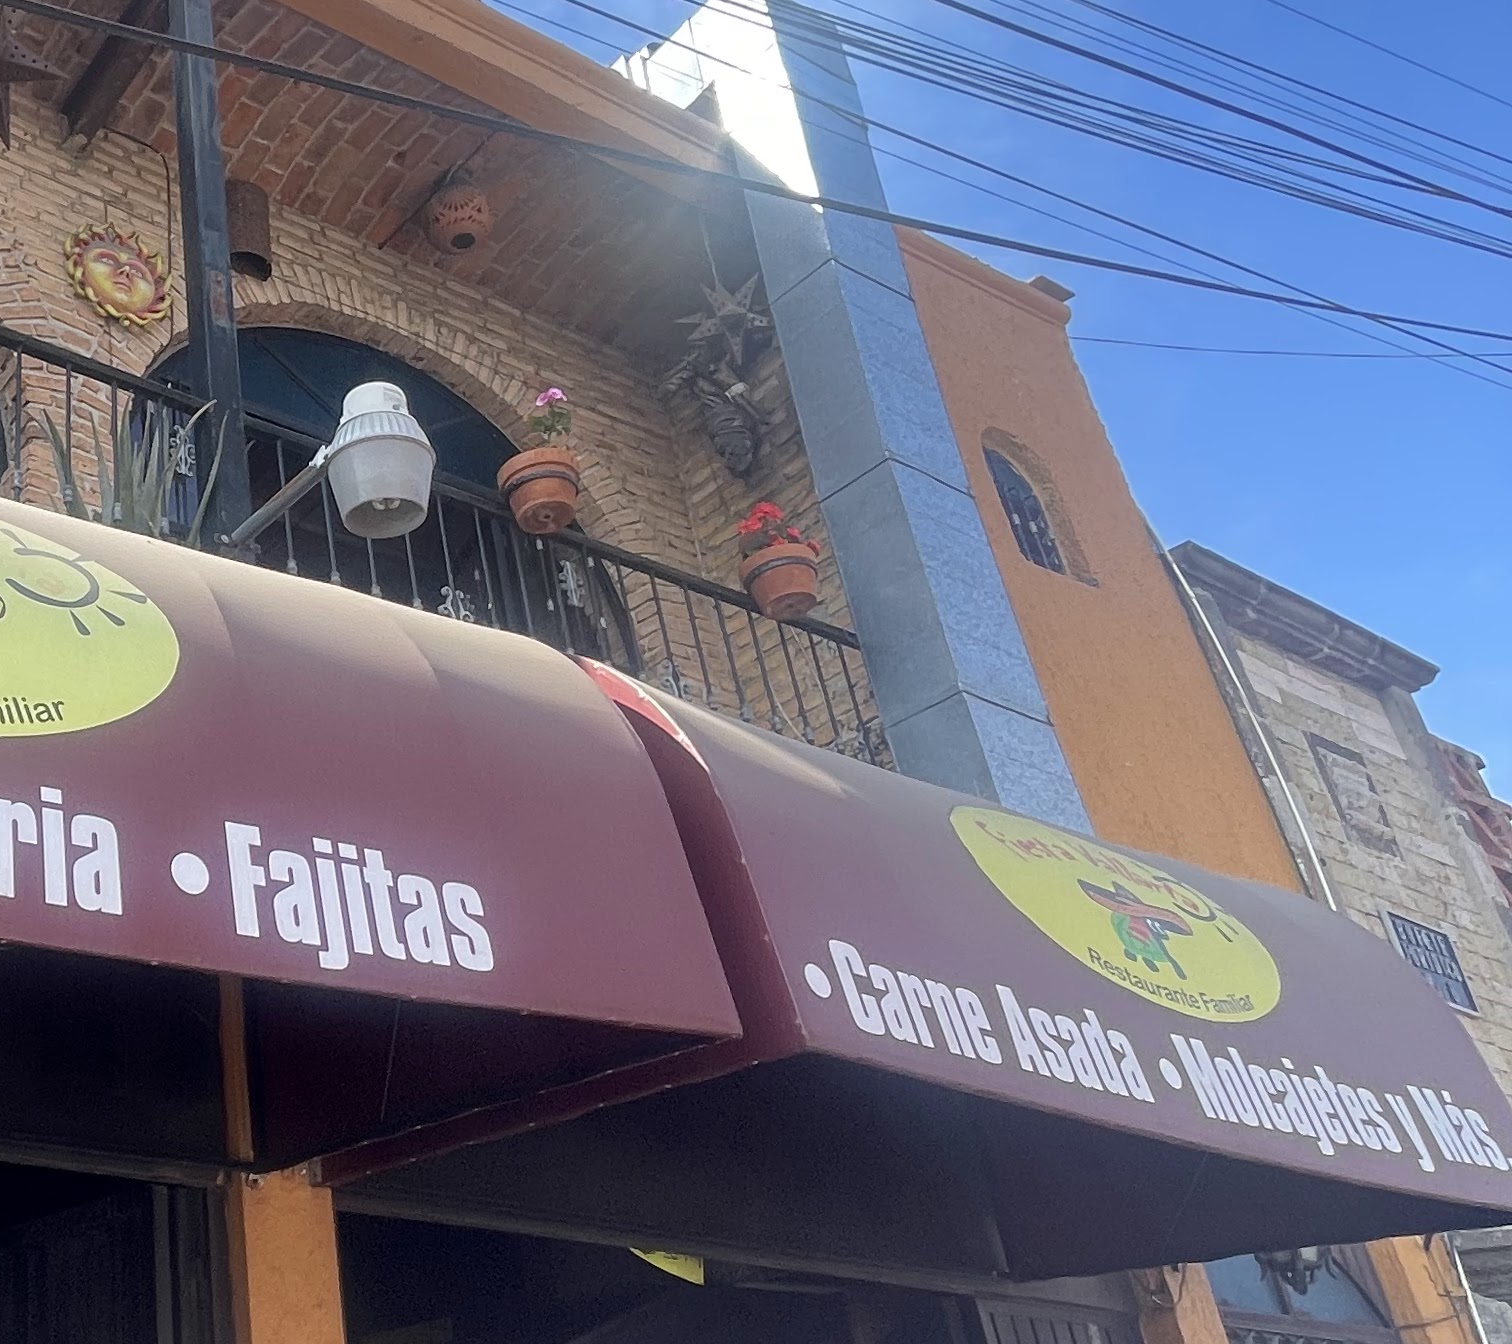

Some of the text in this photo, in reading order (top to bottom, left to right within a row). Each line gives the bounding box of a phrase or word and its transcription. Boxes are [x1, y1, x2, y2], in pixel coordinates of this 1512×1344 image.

[224, 821, 494, 970] Fajitas
[1087, 946, 1255, 1014] Restaurante Familiar
[828, 939, 1003, 1065] Carne
[995, 984, 1155, 1103] Asada
[1170, 1033, 1402, 1155] Molcajetes
[1384, 1093, 1435, 1173] y
